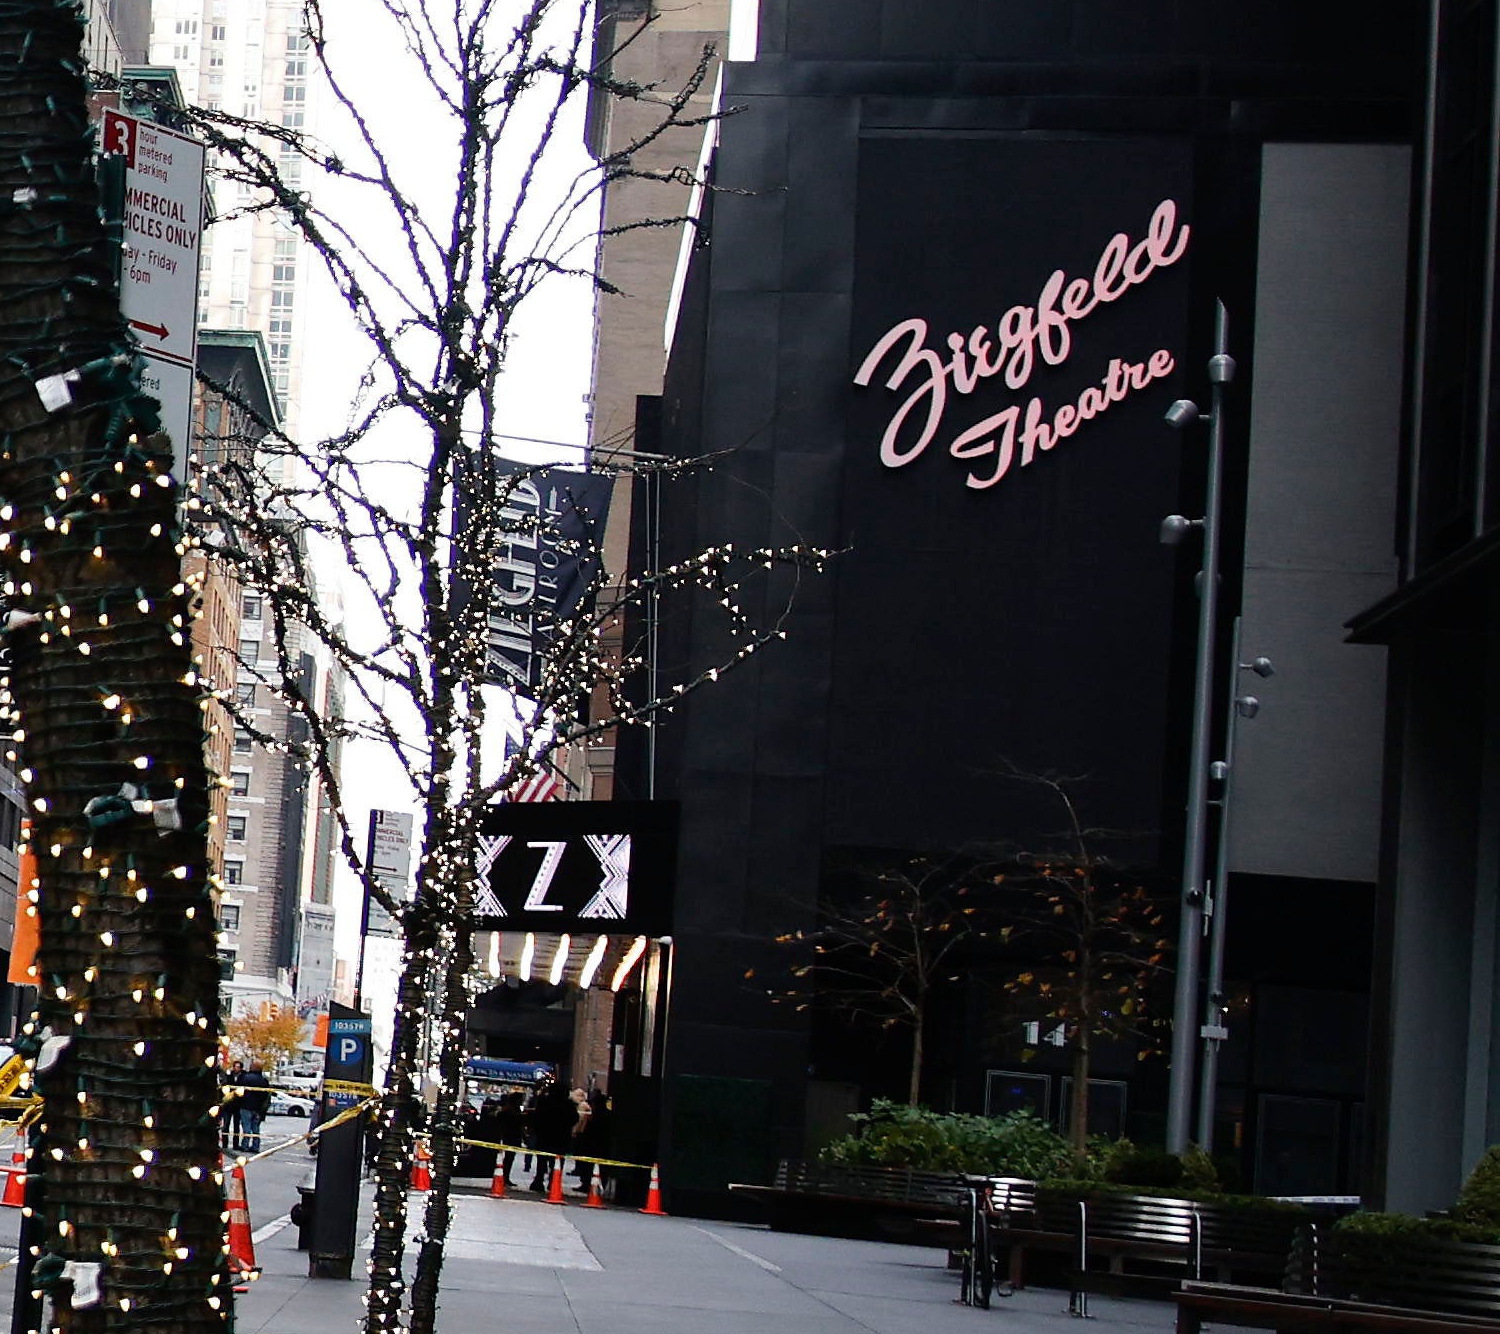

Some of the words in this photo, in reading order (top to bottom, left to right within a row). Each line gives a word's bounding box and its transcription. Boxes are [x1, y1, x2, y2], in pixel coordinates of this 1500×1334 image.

[114, 120, 129, 155] 3
[139, 128, 159, 145] hour
[138, 145, 174, 166] metered
[138, 162, 168, 184] parking
[124, 187, 186, 223] MMERCIAL
[166, 224, 197, 250] ONLY
[129, 265, 151, 284] 6pm
[148, 249, 178, 275] Friday
[853, 198, 1190, 468] Ziegfeld
[949, 347, 1175, 490] Theatre
[523, 841, 568, 911] Z
[340, 1038, 357, 1061] P
